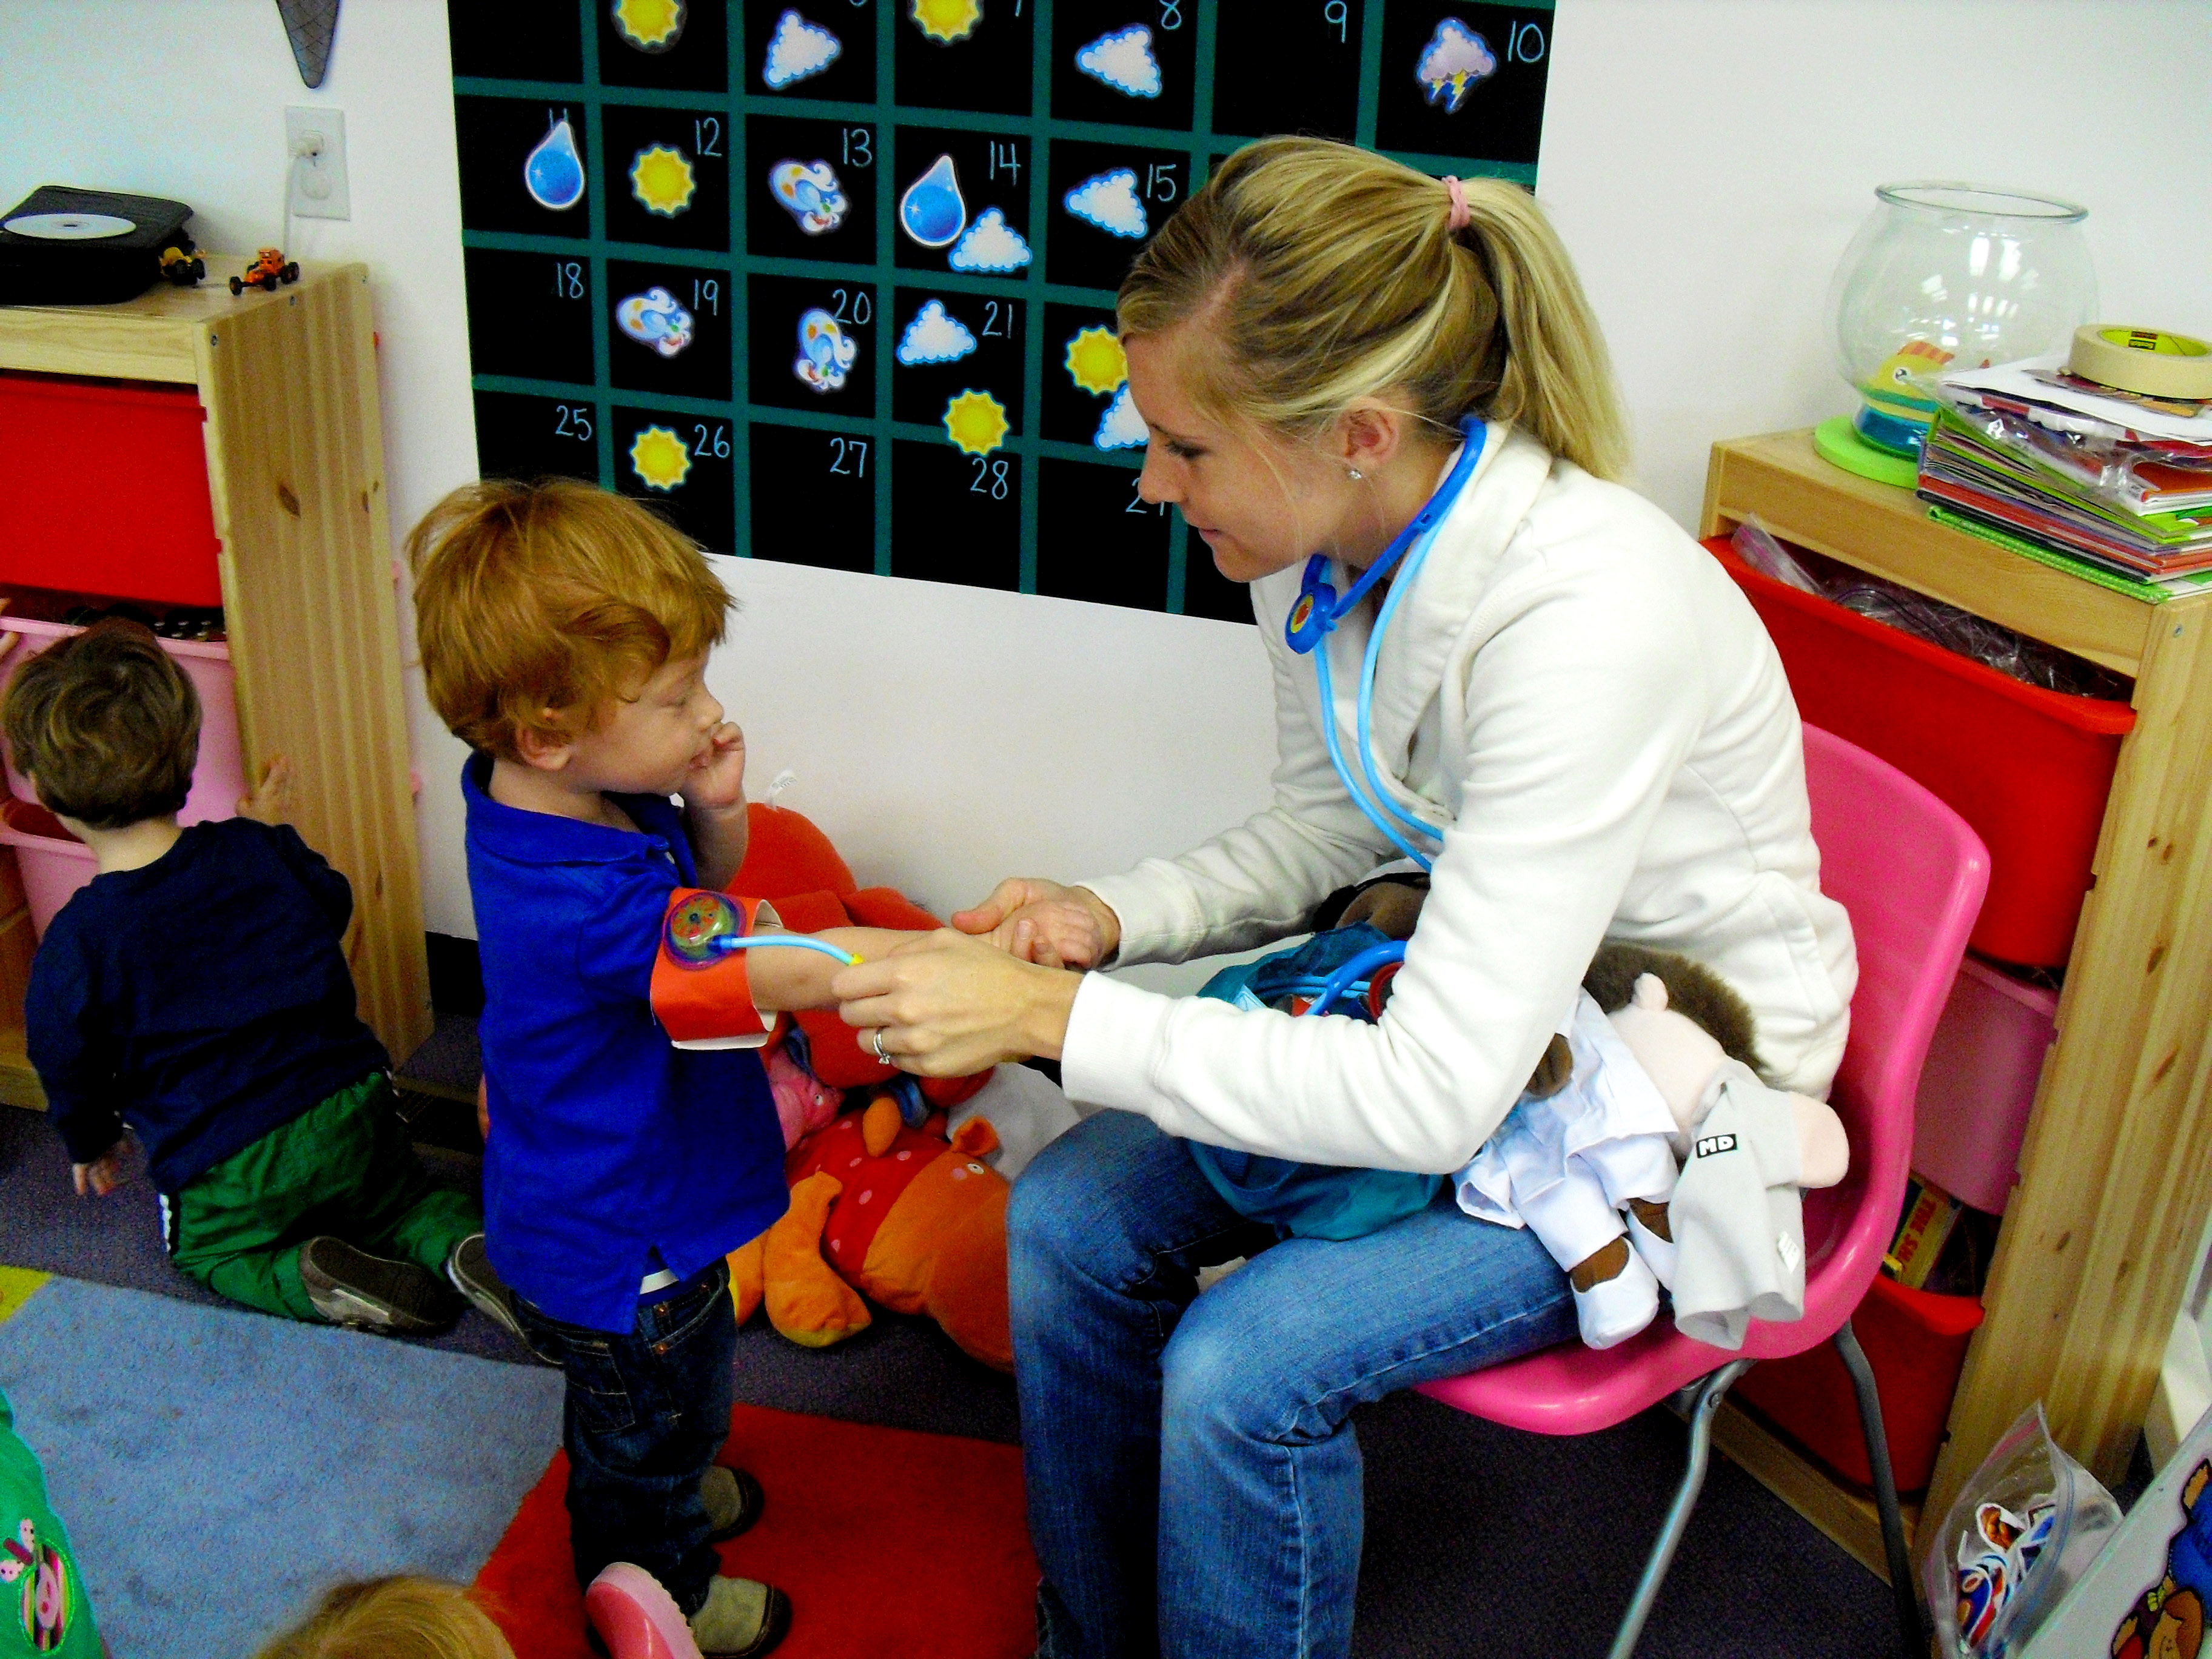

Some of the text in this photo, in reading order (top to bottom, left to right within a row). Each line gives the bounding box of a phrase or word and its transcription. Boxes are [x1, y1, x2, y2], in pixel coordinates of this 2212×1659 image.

[1159, 0, 1182, 30] 8
[1325, 0, 1347, 43] 9
[1507, 21, 1545, 63] 10
[695, 117, 722, 156] 12
[843, 128, 873, 167] 13
[990, 140, 1021, 186] 14
[1146, 164, 1176, 203] 15
[556, 262, 584, 298] 18
[694, 279, 719, 316] 19
[833, 288, 871, 324] 20
[982, 301, 1013, 340] 21
[555, 405, 592, 441] 25
[694, 424, 730, 459] 26
[829, 437, 867, 478] 27
[970, 457, 1009, 500] 28
[1698, 1135, 1734, 1156] MD
